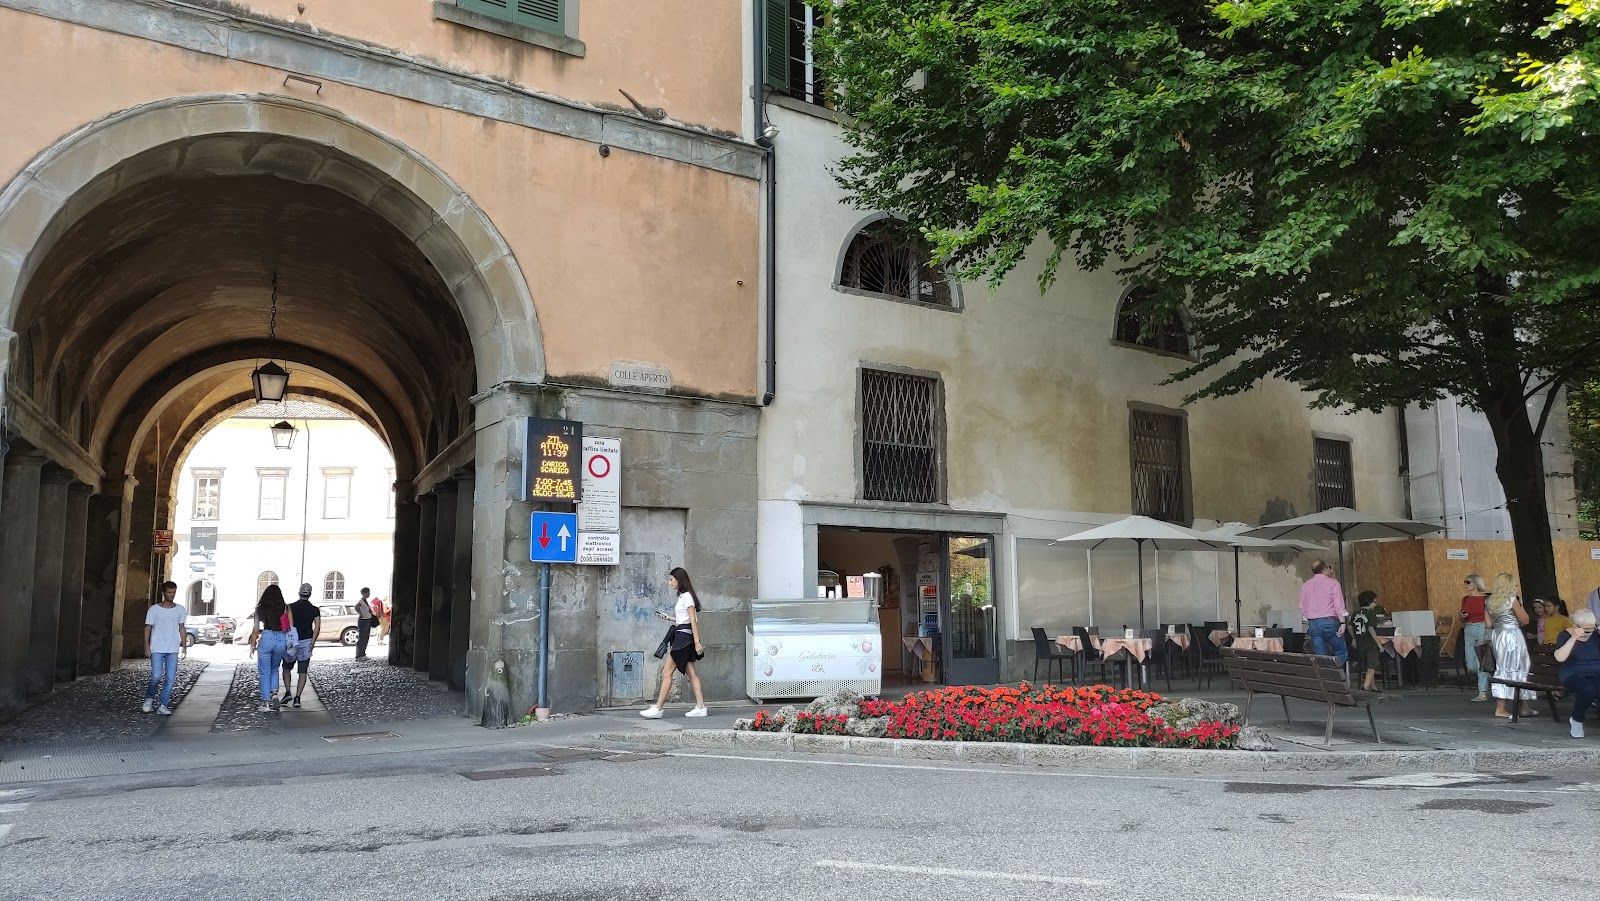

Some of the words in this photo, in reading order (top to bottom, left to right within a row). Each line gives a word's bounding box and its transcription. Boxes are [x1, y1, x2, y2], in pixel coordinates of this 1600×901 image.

[615, 370, 637, 380] COLLE
[641, 372, 668, 383] APERTO
[547, 435, 562, 443] ZTL
[540, 442, 569, 451] ATTIVA
[542, 449, 567, 458] 11:39
[535, 478, 573, 486] 7.00-7.45
